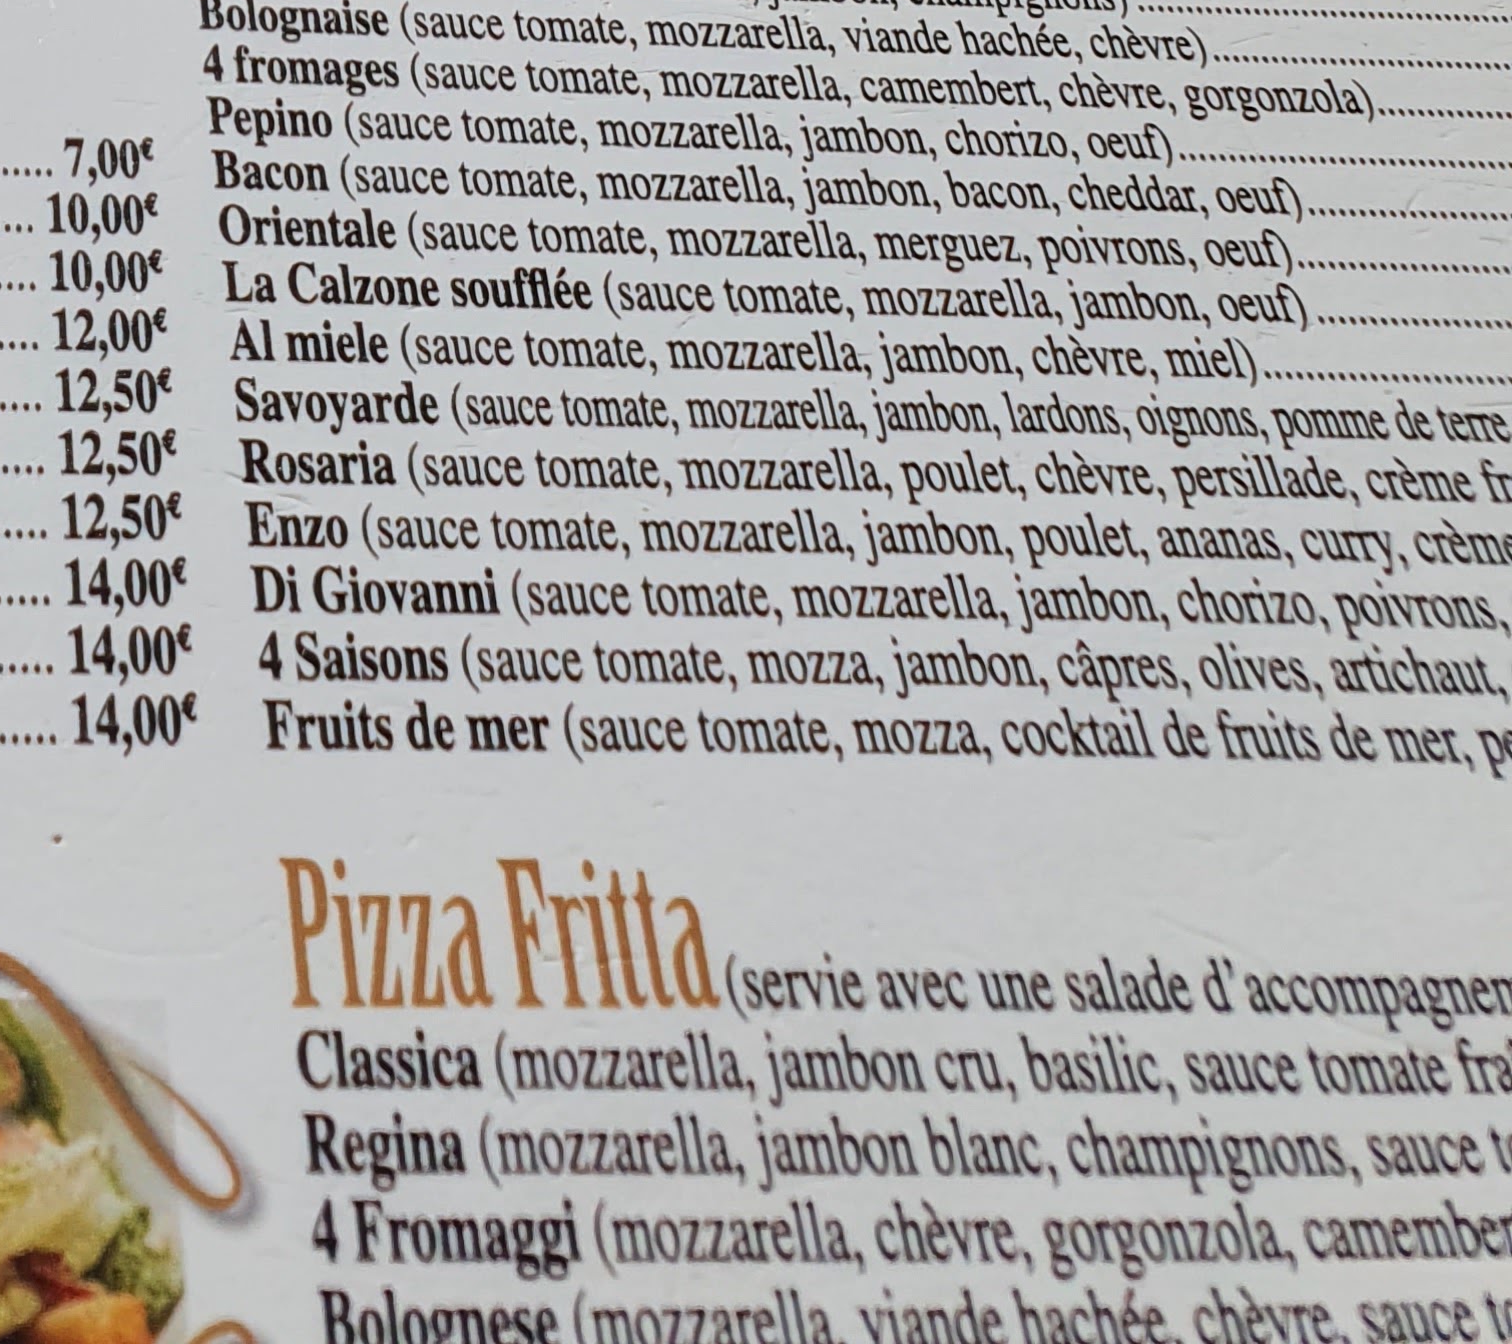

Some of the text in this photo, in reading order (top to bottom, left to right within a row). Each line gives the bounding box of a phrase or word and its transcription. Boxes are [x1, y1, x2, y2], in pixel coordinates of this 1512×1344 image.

[203, 45, 1374, 122] 4 fromages (sauce tomate, mozzarella, camembert, chèvre, gorgonzola)
[48, 192, 158, 242] 10,00€
[50, 249, 162, 300] 10,00€
[222, 261, 1308, 331] La Calzone soufflée (sauce tomate, mozzarella, jambon, oeuf)
[53, 307, 167, 360] 12,00€
[56, 367, 172, 420] 12,50€
[69, 623, 192, 684] 14,00€
[73, 692, 197, 755] 14,00€
[263, 699, 394, 751] Fruits
[406, 701, 455, 751] de
[466, 716, 549, 751] mer
[564, 704, 687, 761] (sauce
[698, 712, 843, 761] tomate,
[852, 719, 992, 762] mozza,
[1001, 707, 1155, 758] cocktail
[1163, 709, 1209, 758] de
[1217, 709, 1321, 761] fruits
[1330, 712, 1377, 761] de
[1384, 728, 1473, 770] mer,
[279, 857, 493, 1009] Pizza
[496, 857, 722, 1009] Fritta
[725, 953, 866, 1019] (servie
[877, 971, 968, 1011] avec
[978, 972, 1055, 1012] une
[1065, 956, 1193, 1013] salade
[297, 1029, 1512, 1108] Classica (mozzarella, jambon cru, basilic, sauce tomate fra
